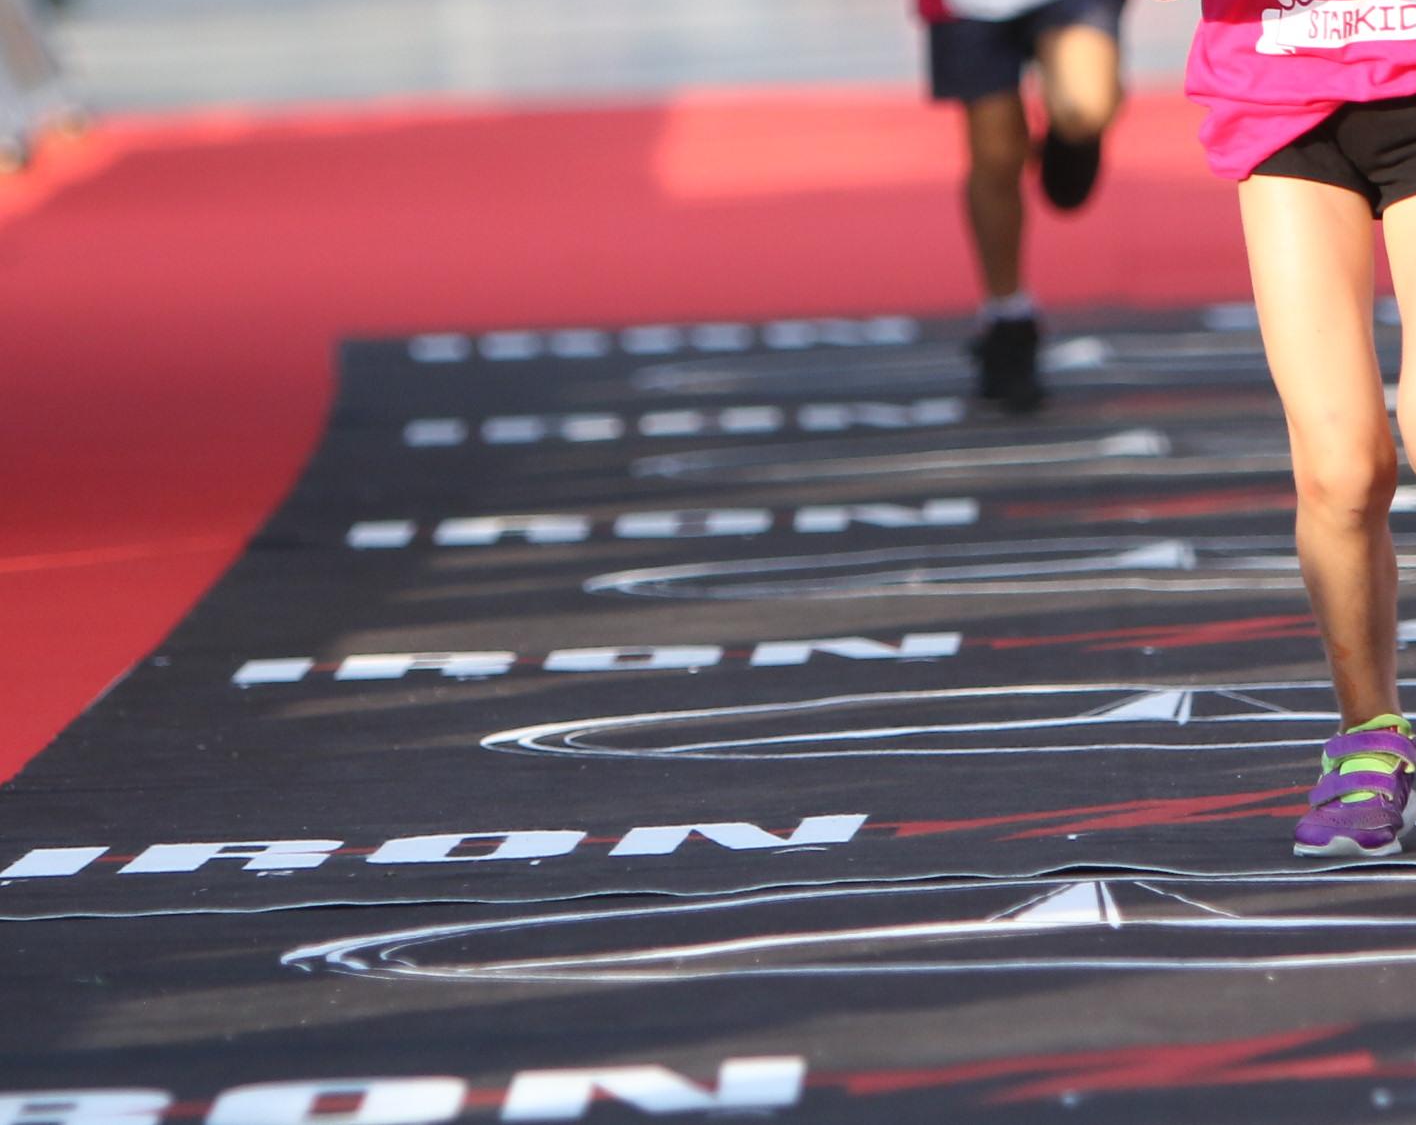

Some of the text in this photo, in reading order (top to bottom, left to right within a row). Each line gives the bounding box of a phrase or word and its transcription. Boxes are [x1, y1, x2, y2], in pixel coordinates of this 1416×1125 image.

[345, 497, 981, 549] IRON
[232, 631, 962, 684] IRON
[0, 814, 869, 877] IRON
